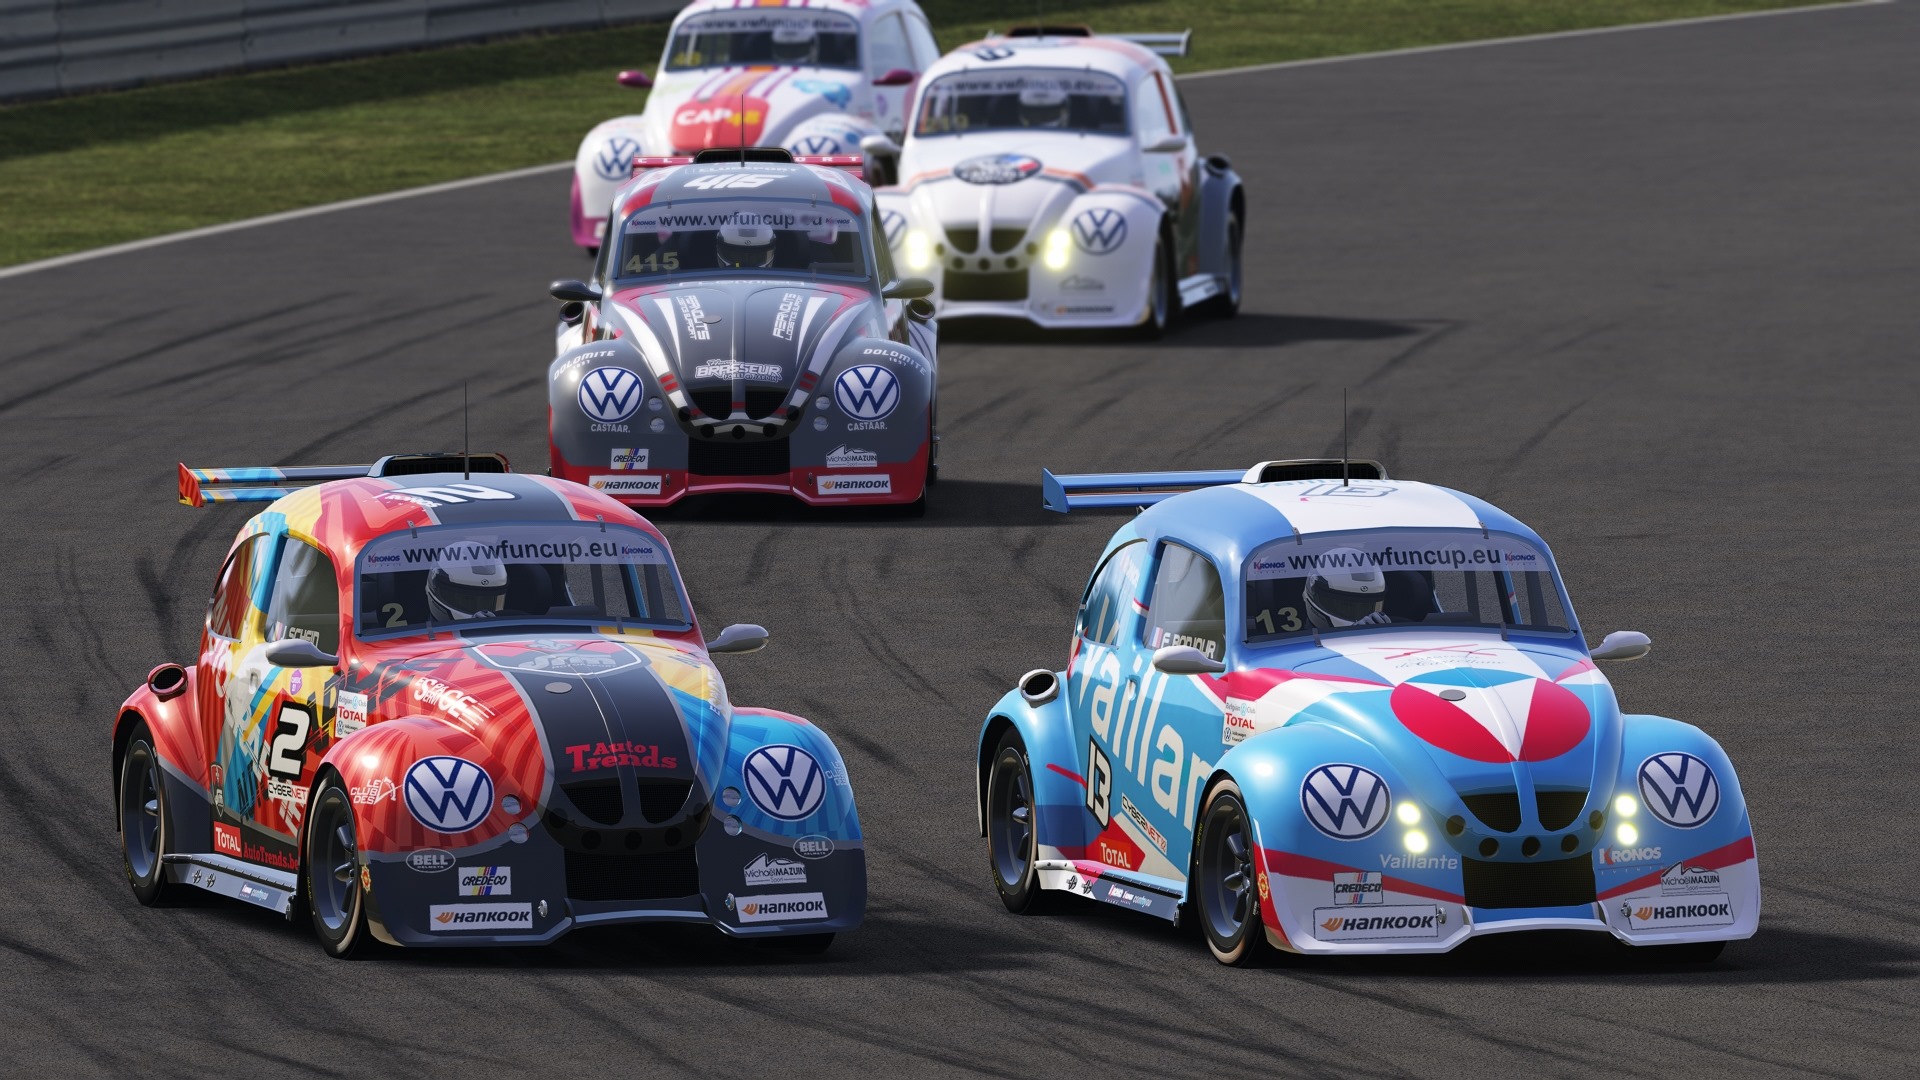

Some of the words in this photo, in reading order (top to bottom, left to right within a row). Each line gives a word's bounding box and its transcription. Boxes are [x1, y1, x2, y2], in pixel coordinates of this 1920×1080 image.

[683, 173, 789, 190] 415
[626, 251, 680, 274] 415
[695, 363, 782, 378] BRASSEUR
[613, 454, 646, 463] CREDECO
[403, 540, 618, 563] www.vwfuncup.eu
[1288, 547, 1501, 569] www.vwfuncup.eu
[382, 602, 407, 628] 2
[1256, 606, 1302, 634] 13
[338, 706, 366, 722] TOTAL
[1225, 712, 1255, 730] TOTAL
[270, 706, 311, 776] 2
[594, 741, 647, 755] Auto
[566, 743, 677, 773] Trends
[350, 786, 378, 796] CLUB
[366, 779, 382, 788] LE
[742, 744, 826, 821] VW
[1086, 738, 1111, 829] 13
[1637, 751, 1720, 829] VW
[353, 795, 375, 805] DES
[404, 755, 494, 833] VW
[1300, 763, 1392, 841] VW
[216, 827, 241, 852] TOTAL
[244, 843, 299, 870] AutoTrends.be
[800, 841, 829, 851] BELL
[1101, 843, 1131, 869] TOTAL
[1599, 845, 1662, 865] KRONOS
[413, 855, 448, 866] BELL
[1380, 853, 1458, 870] Vaillante
[462, 876, 508, 887] CREDECO
[1334, 883, 1382, 893] CREDECO
